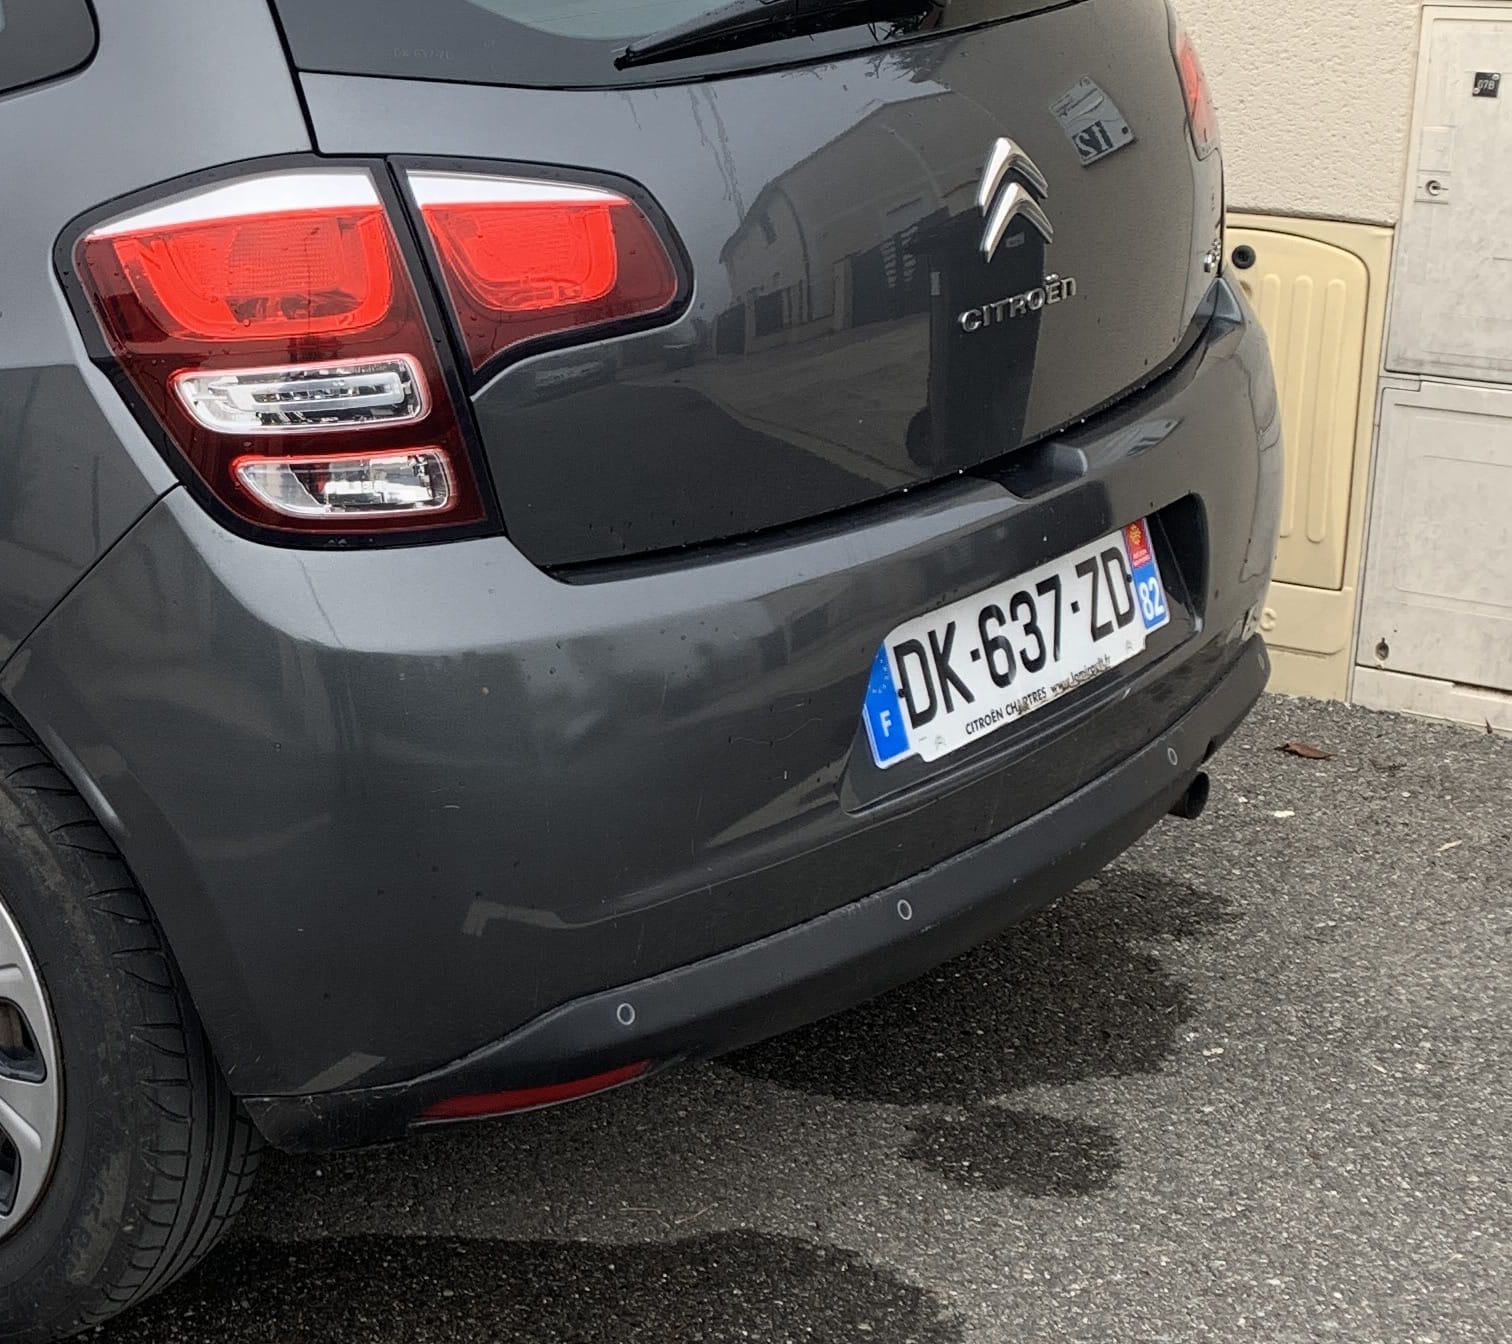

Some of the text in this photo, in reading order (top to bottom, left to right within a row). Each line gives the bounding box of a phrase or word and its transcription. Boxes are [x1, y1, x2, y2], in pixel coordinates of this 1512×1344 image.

[1138, 576, 1165, 621] 82
[893, 546, 1136, 729] DK-637-ZD
[879, 710, 893, 738] F
